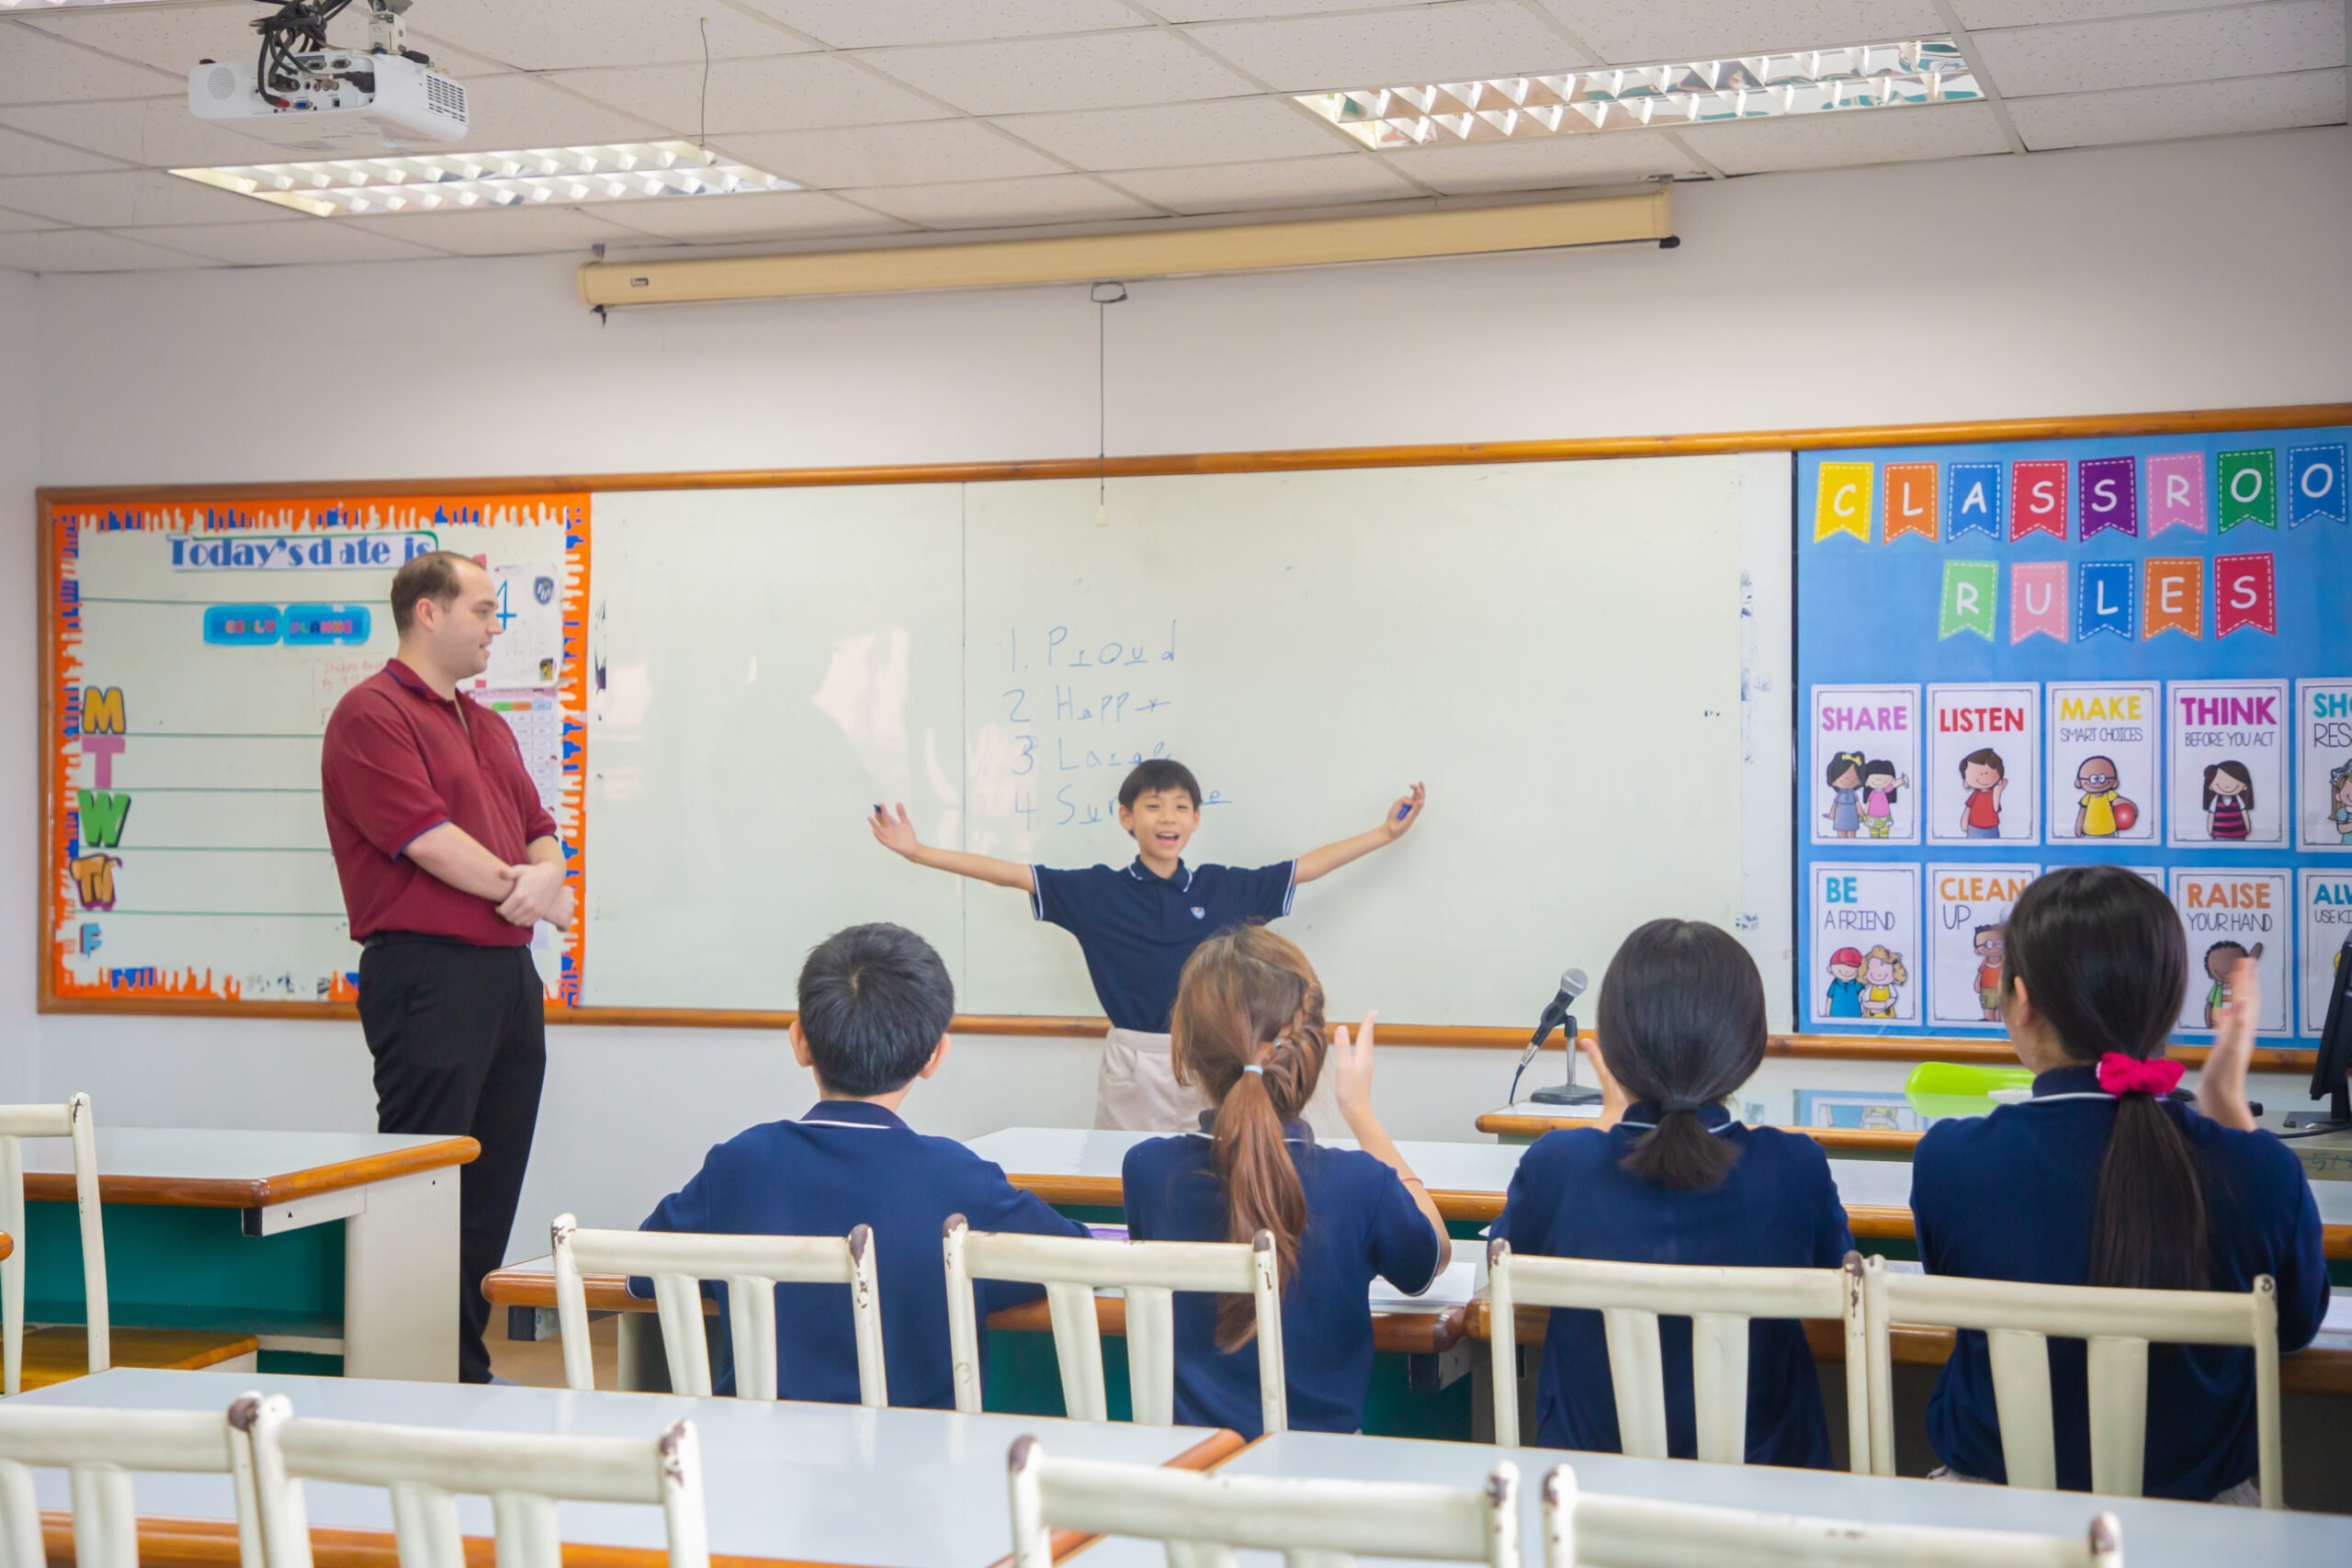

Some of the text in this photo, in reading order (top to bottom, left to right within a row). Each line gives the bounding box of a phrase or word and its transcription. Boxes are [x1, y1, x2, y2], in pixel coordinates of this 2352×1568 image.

[166, 536, 303, 567] Today's
[1956, 575, 2257, 616] RULES
[1047, 618, 1176, 666] Proud
[82, 685, 126, 734] M
[1001, 684, 1170, 723] 2 Happy
[2060, 695, 2142, 721] MAKE
[2180, 696, 2278, 726] THINK
[2313, 693, 2352, 718] SH
[1822, 705, 1907, 731] SHARE
[1939, 707, 2024, 732] LISTEN
[2060, 727, 2143, 742] SMART CHOICES
[2185, 731, 2275, 747] BEFORE YOU ACT
[82, 738, 125, 789] T
[1011, 736, 1035, 774] 3
[77, 790, 130, 847] W
[1015, 791, 1036, 830] 4
[1826, 876, 1858, 903] BE
[1939, 877, 2027, 902] CLEAN
[2188, 883, 2271, 908] RAISE
[1825, 910, 1895, 931] A FRIEND
[1943, 905, 1971, 930] UP
[2187, 912, 2273, 931] YOUR HAND
[2314, 909, 2335, 923] USE
